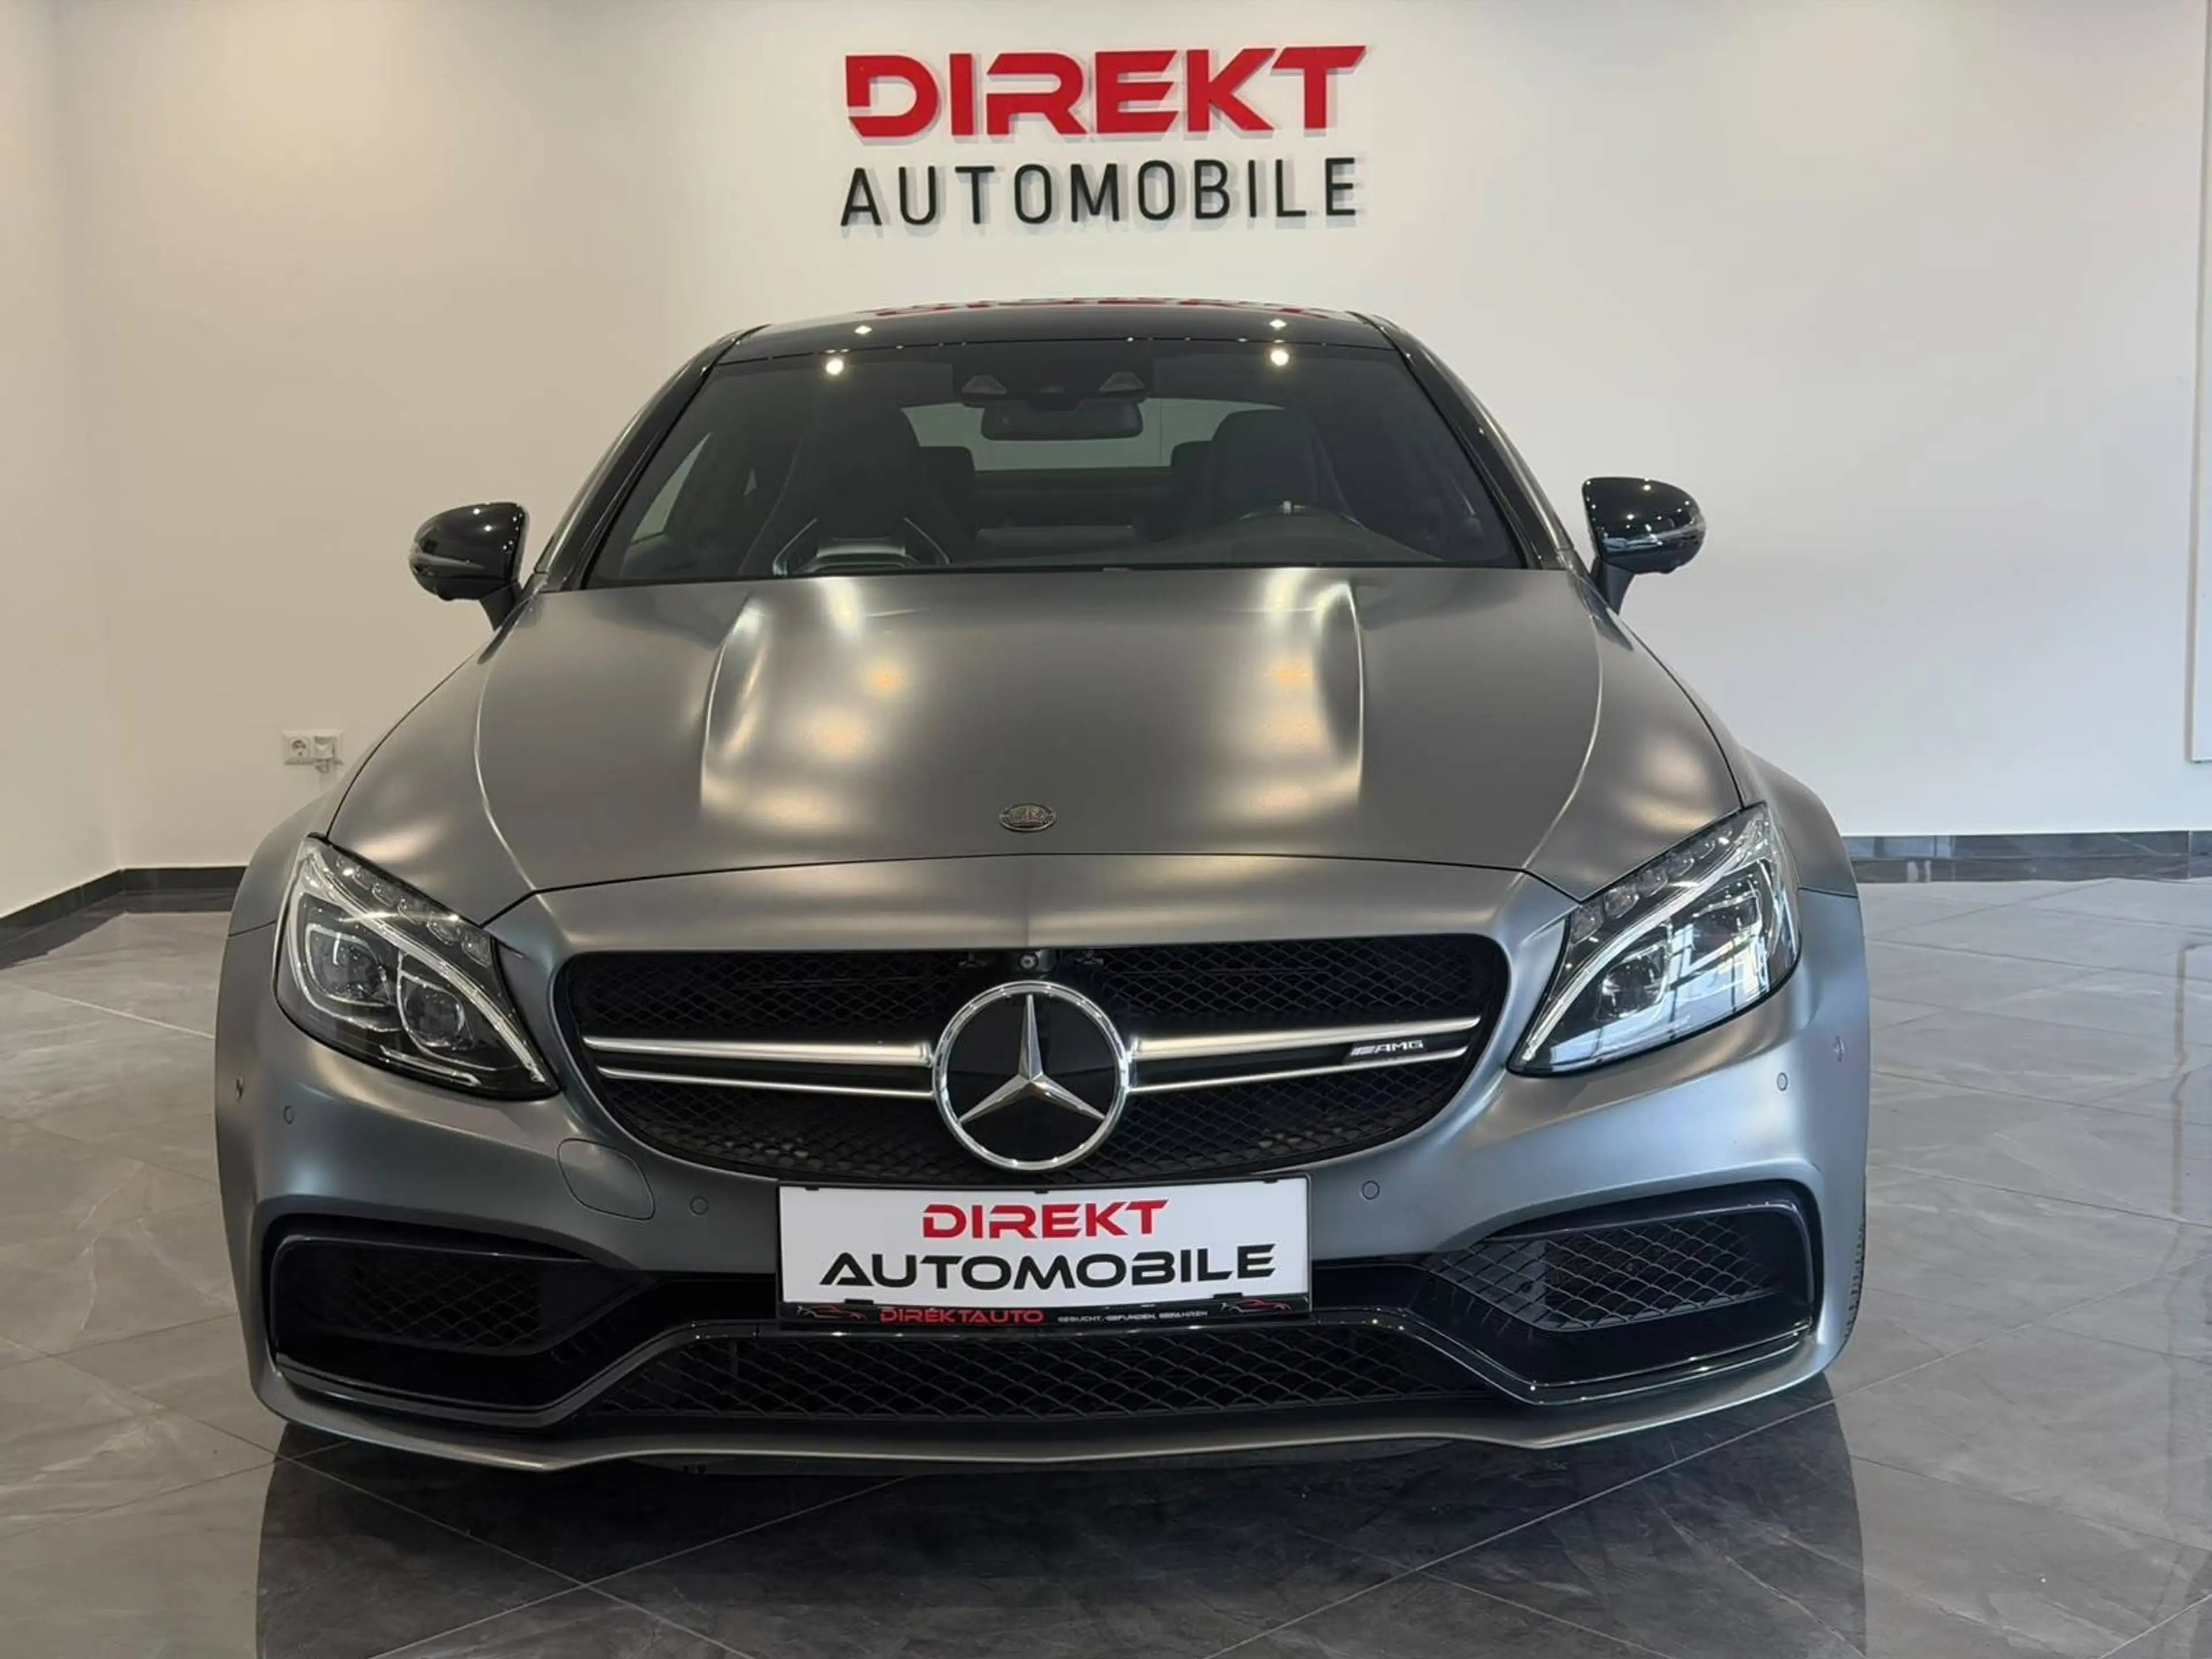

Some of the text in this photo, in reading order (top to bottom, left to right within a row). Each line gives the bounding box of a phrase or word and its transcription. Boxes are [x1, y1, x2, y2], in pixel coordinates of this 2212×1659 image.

[844, 45, 1366, 137] DIREKT
[841, 157, 1357, 226] AUTOMOBILE
[1371, 1040, 1423, 1053] AMG
[922, 1199, 1169, 1239] DIREKT
[820, 1244, 1277, 1290] AUTOMOBILE
